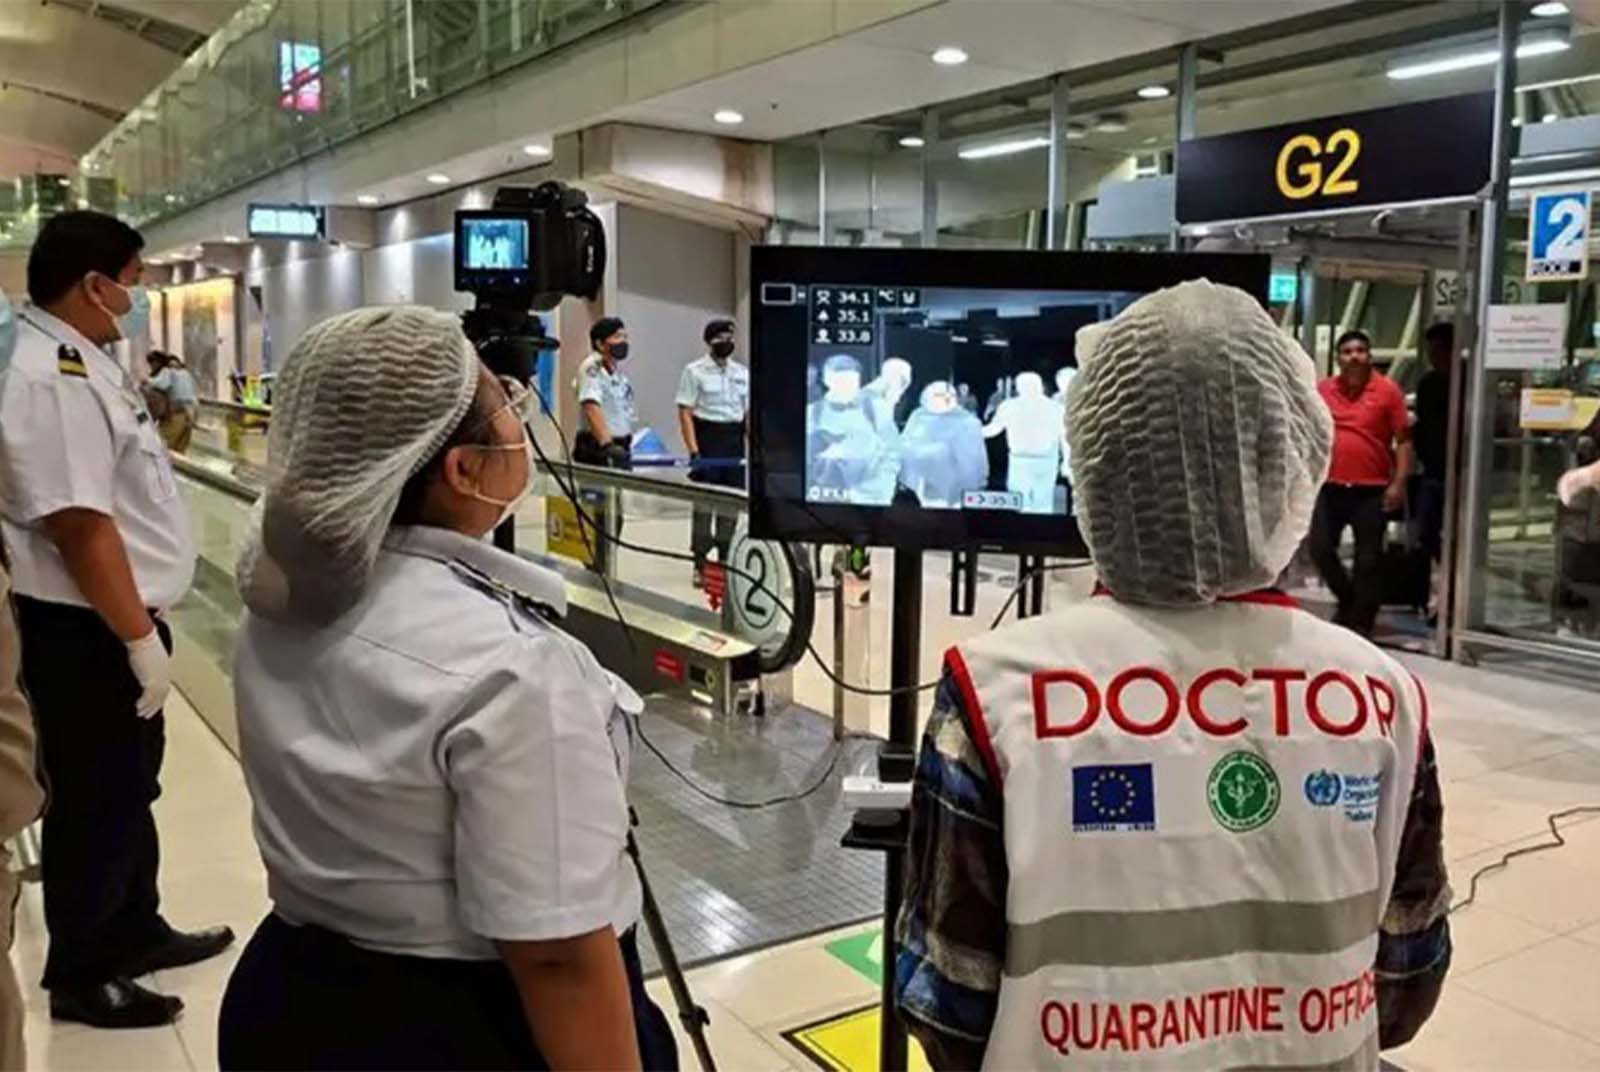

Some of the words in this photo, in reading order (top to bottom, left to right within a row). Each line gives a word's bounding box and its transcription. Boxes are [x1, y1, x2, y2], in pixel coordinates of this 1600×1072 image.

[1276, 128, 1360, 199] G2
[1545, 198, 1585, 258] 2
[838, 291, 871, 304] 34.1
[838, 310, 870, 323] 35.1
[745, 547, 766, 616] 2
[1031, 666, 1395, 739] DOCTOR
[1041, 987, 1284, 1055] QUARANTINE
[1299, 972, 1375, 1034] OFFIC
